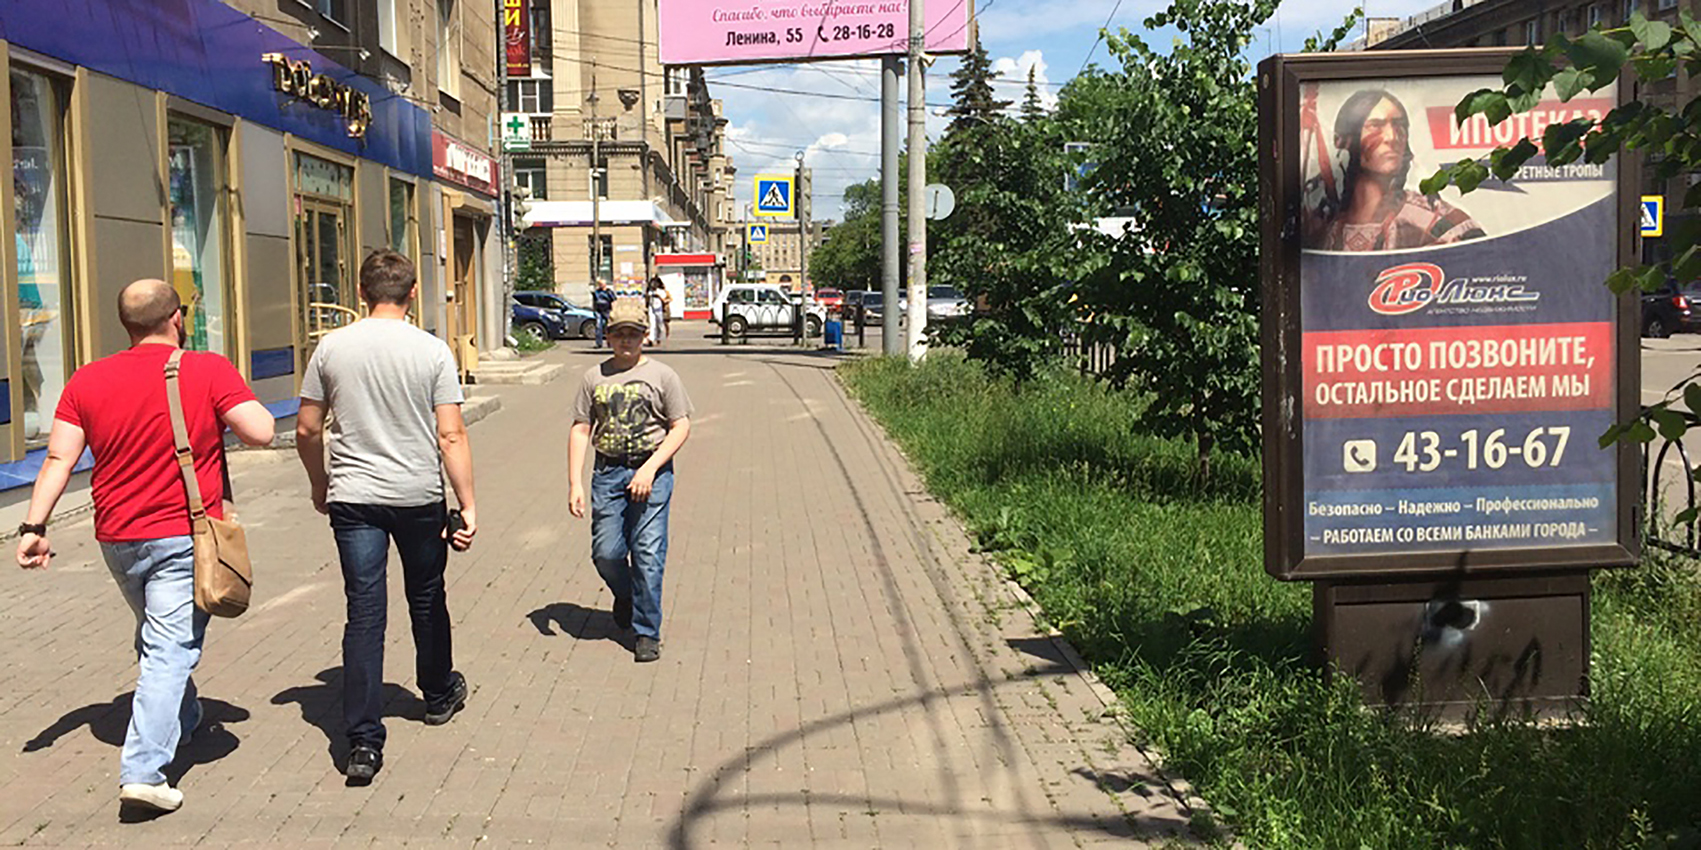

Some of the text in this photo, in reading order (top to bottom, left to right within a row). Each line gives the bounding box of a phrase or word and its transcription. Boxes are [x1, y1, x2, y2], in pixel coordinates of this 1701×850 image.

[771, 9, 799, 19] что
[800, 3, 876, 20] выбираете
[878, 0, 907, 14] нас!
[725, 23, 895, 46] Ленина, 55 28-16-28
[1563, 164, 1603, 178] ТРОПЫ
[1316, 337, 1595, 373] ПРОСТО ПОЗВОНИТЕ,
[1315, 374, 1590, 405] ОСТАЛЬНОЕ СДЕЛАЕМ МЫ
[1394, 426, 1571, 472] 43-16-67
[1309, 501, 1382, 516] Безопасно
[1399, 499, 1461, 516] Надежно
[1476, 496, 1599, 513] Профессионально
[1323, 527, 1393, 544] РАБОТАЕМ
[1397, 527, 1414, 542] СО
[1417, 526, 1463, 542] ВСЕМИ
[1465, 524, 1531, 540] БАНКАМИ
[1534, 522, 1586, 538] ГОРОДА
